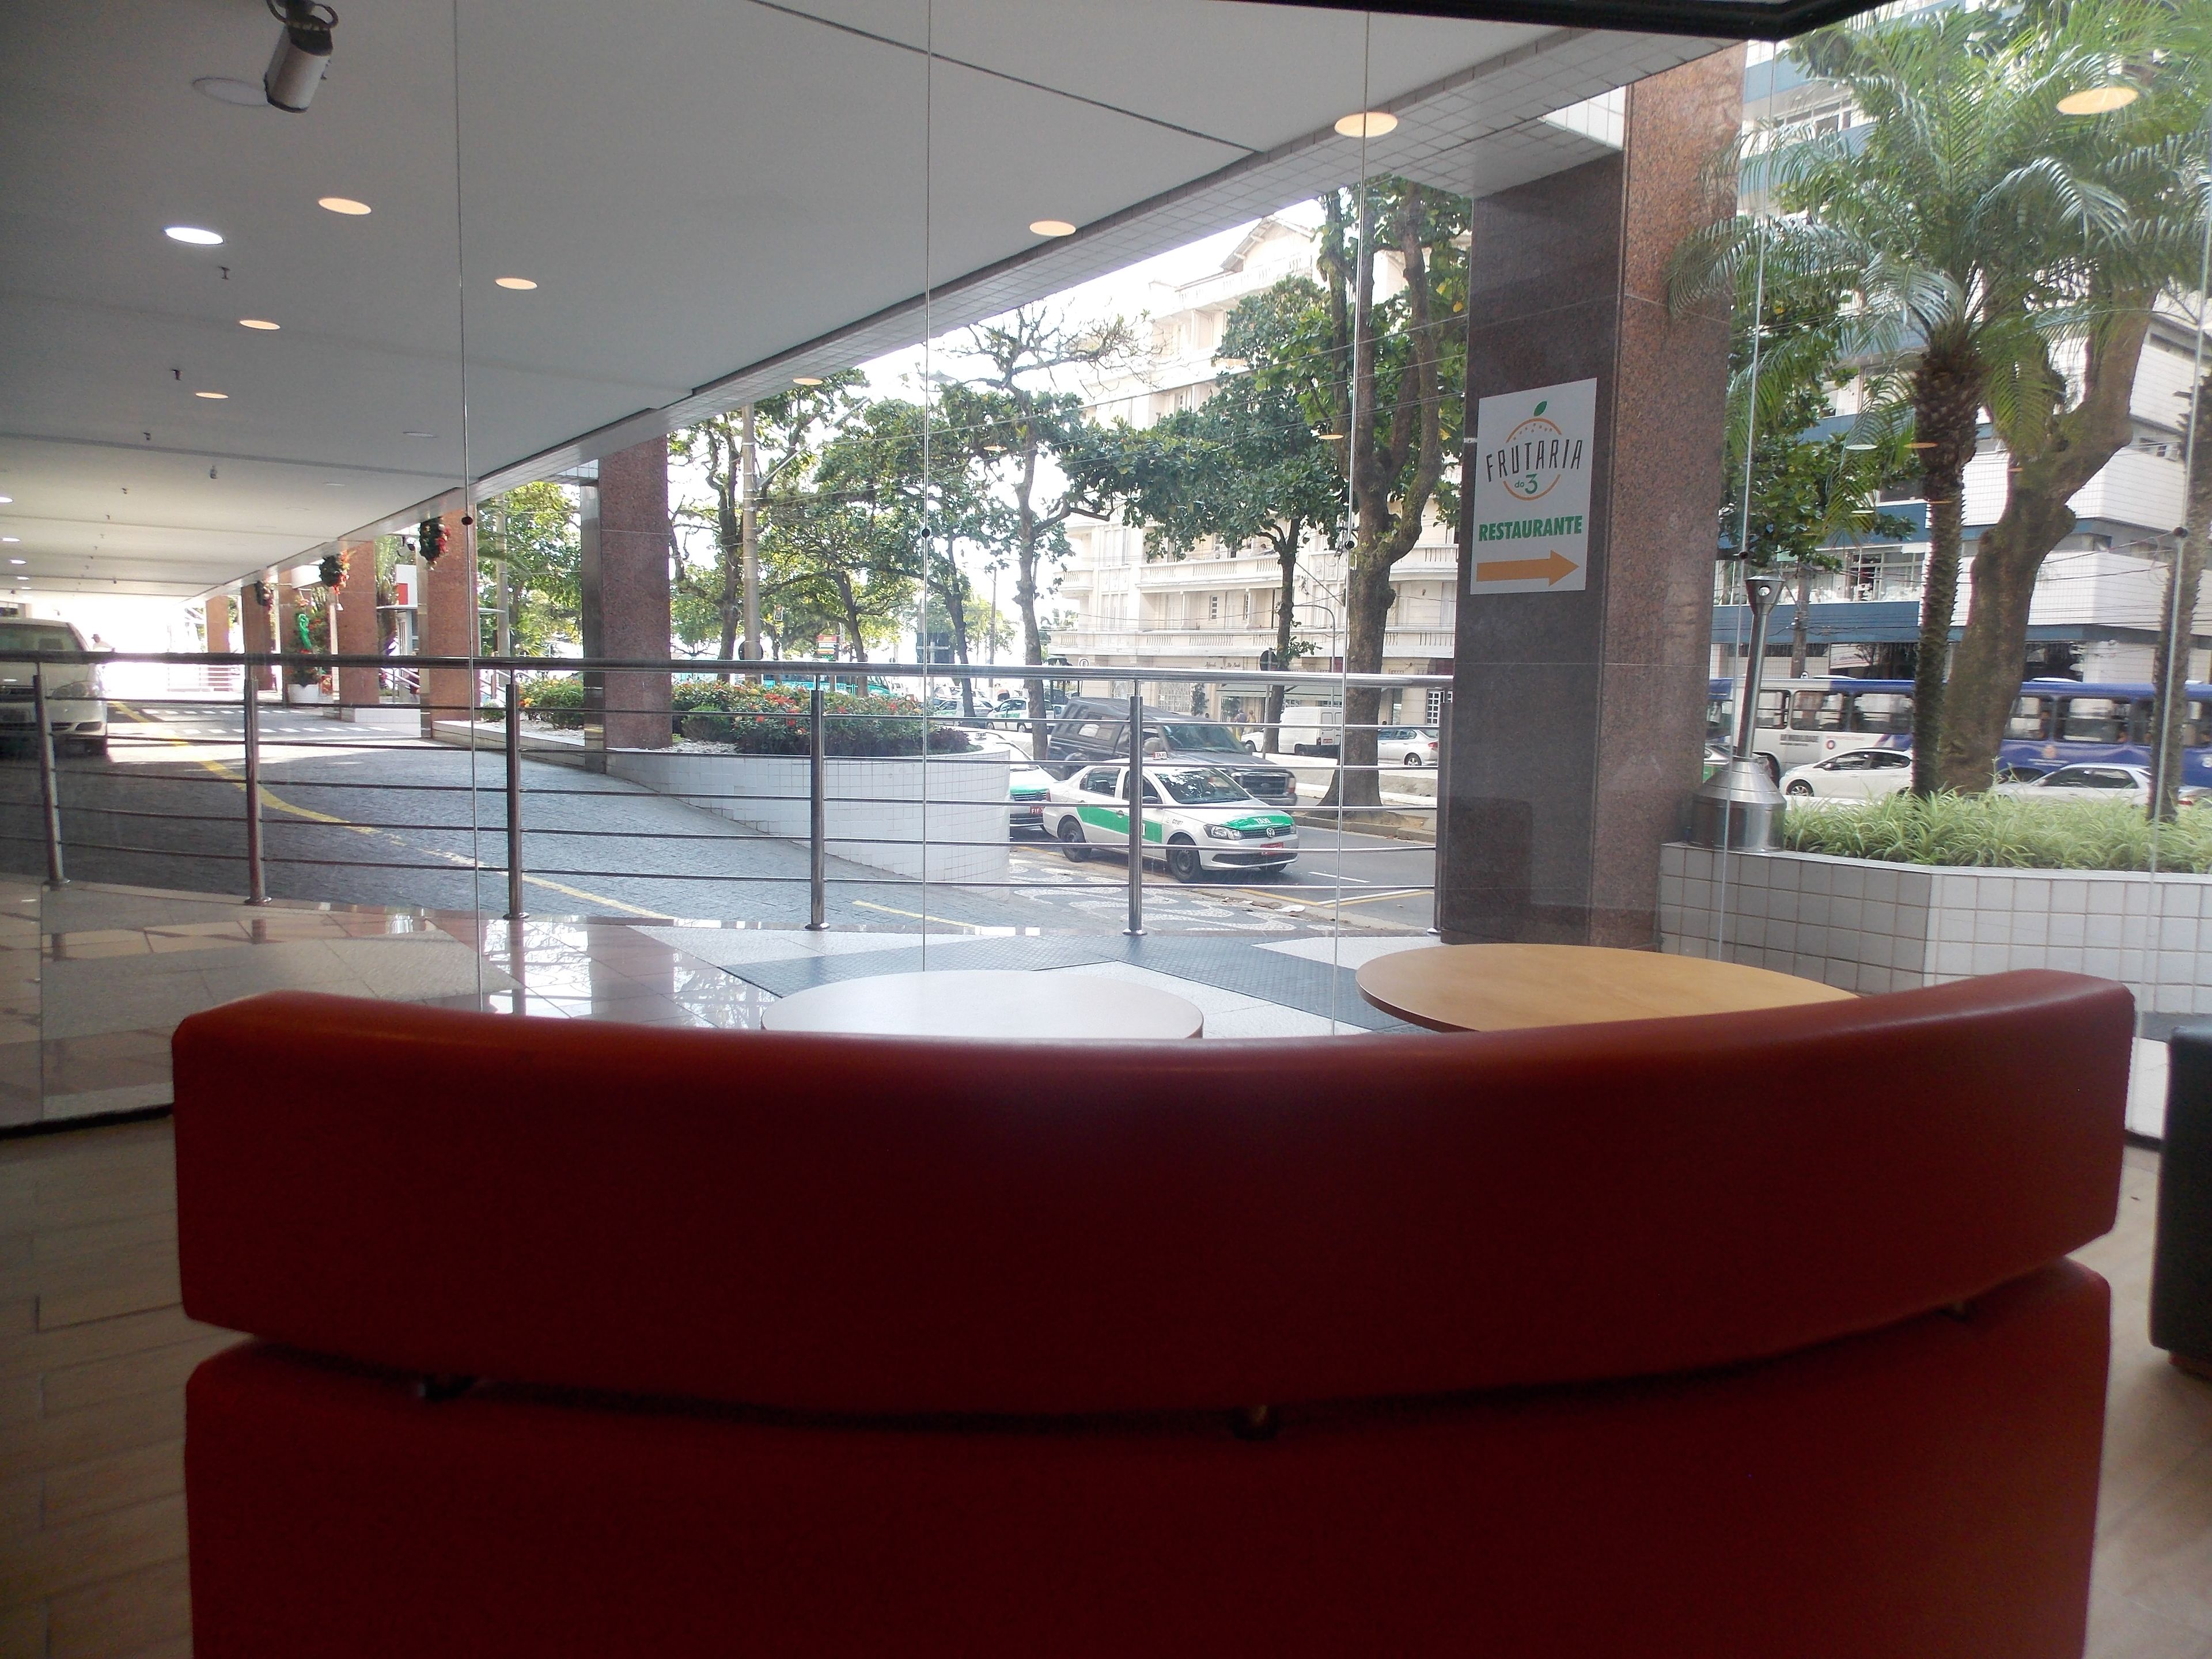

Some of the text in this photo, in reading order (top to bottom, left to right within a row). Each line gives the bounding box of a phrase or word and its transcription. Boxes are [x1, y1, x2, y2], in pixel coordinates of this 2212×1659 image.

[1486, 439, 1583, 483] FRUTARIA
[1514, 474, 1538, 495] do 3
[1478, 515, 1583, 541] RESTAURANTE
